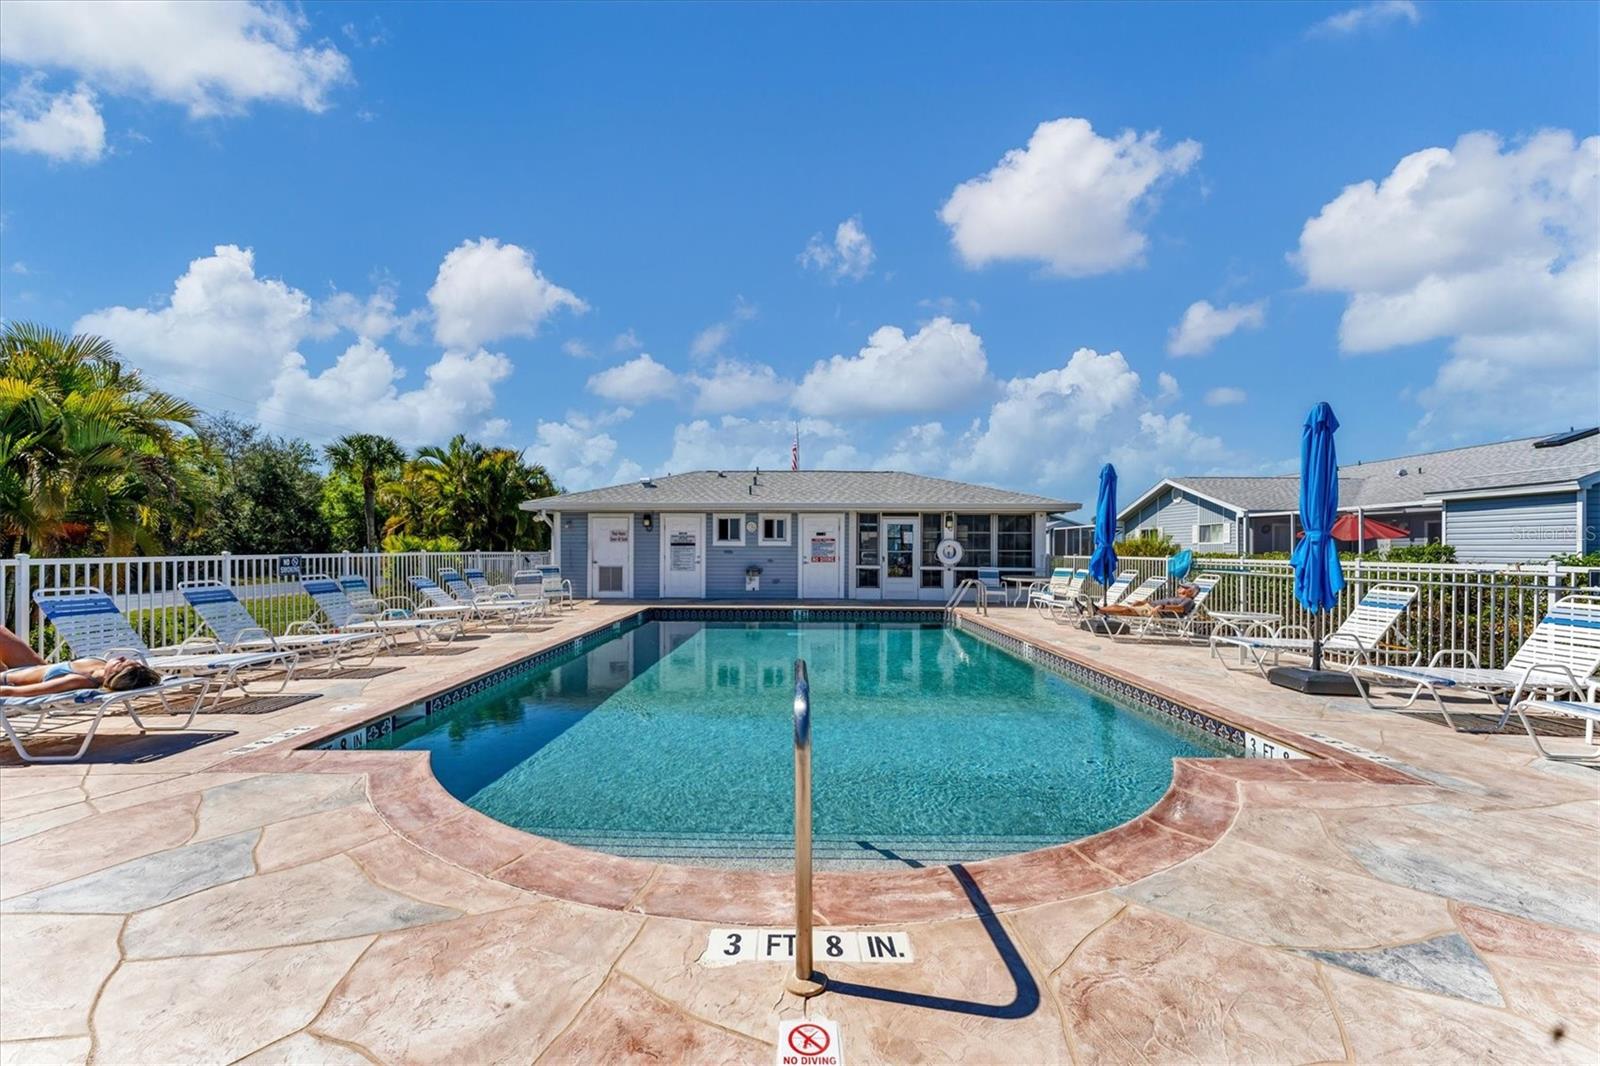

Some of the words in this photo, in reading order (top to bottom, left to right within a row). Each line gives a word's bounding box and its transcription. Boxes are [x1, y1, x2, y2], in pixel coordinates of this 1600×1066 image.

[283, 558, 290, 566] NO
[1263, 743, 1275, 759] FT
[723, 933, 742, 956] 3
[766, 933, 797, 956] FT
[825, 935, 844, 957] 8
[866, 935, 905, 957] IN.
[783, 1056, 798, 1064] NO
[801, 1056, 837, 1064] DIVING
